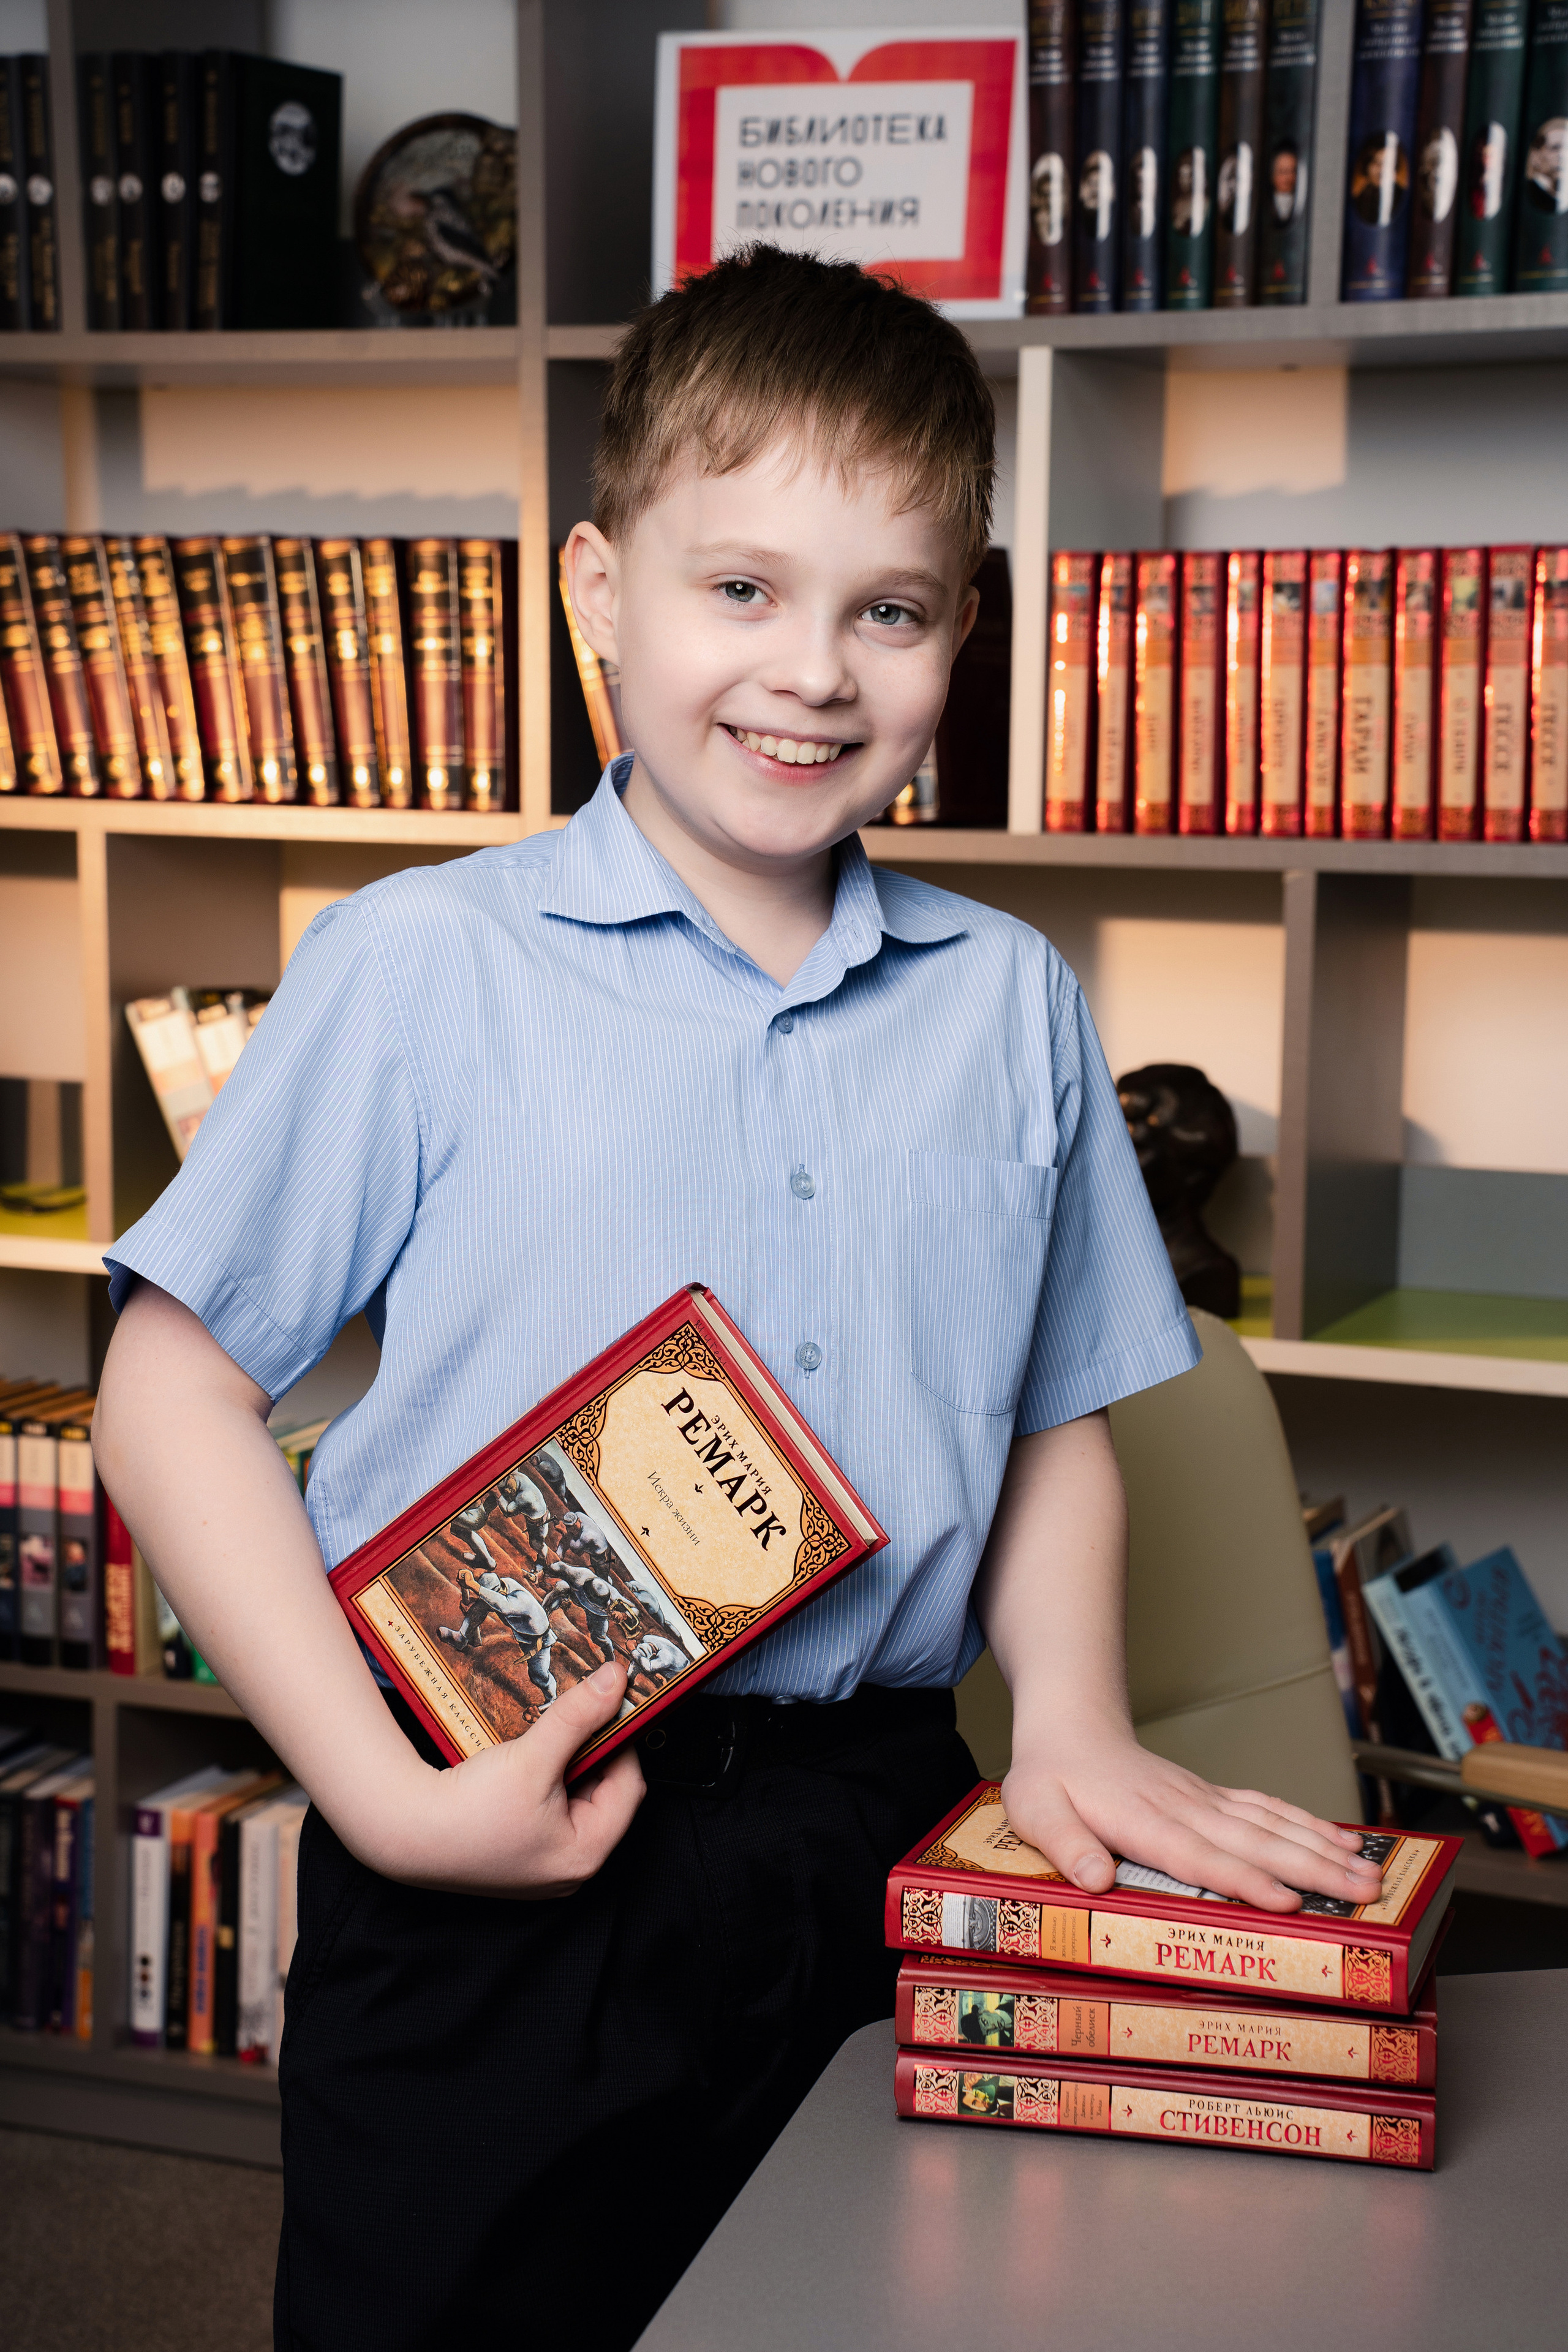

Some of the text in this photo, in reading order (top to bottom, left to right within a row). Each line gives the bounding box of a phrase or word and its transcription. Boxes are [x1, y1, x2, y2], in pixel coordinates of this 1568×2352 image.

[739, 114, 946, 148] БИБЛИОТЕКА
[737, 156, 863, 189] НОВОГО
[736, 196, 921, 229] ПОКОЛЕНИЯ
[660, 1386, 787, 1551] РЕМАРК
[711, 1415, 773, 1496] ЭРИХ МАРИЯ
[647, 1469, 701, 1546] Искра жизни
[394, 1625, 486, 1751] ЗАРУБЕЖНАЯ КЛАССИ
[982, 1817, 1010, 1844] ЭРИХ МАРИ
[992, 1830, 1023, 1851] РЕМ
[1167, 1927, 1265, 1951] ЭРИХ МАРИЯ
[1155, 1942, 1278, 1982] РЕМАРК
[1071, 2005, 1084, 2047] Черный
[1085, 2008, 1095, 2048] обелиск
[1198, 2019, 1281, 2036] ЭРИХ МАРИЯ
[1187, 2032, 1292, 2062] РЕМАРК
[1189, 2098, 1294, 2120] РОБЕРТ ЛЬЮИС
[1159, 2109, 1323, 2147] СТИВЕНСОН
